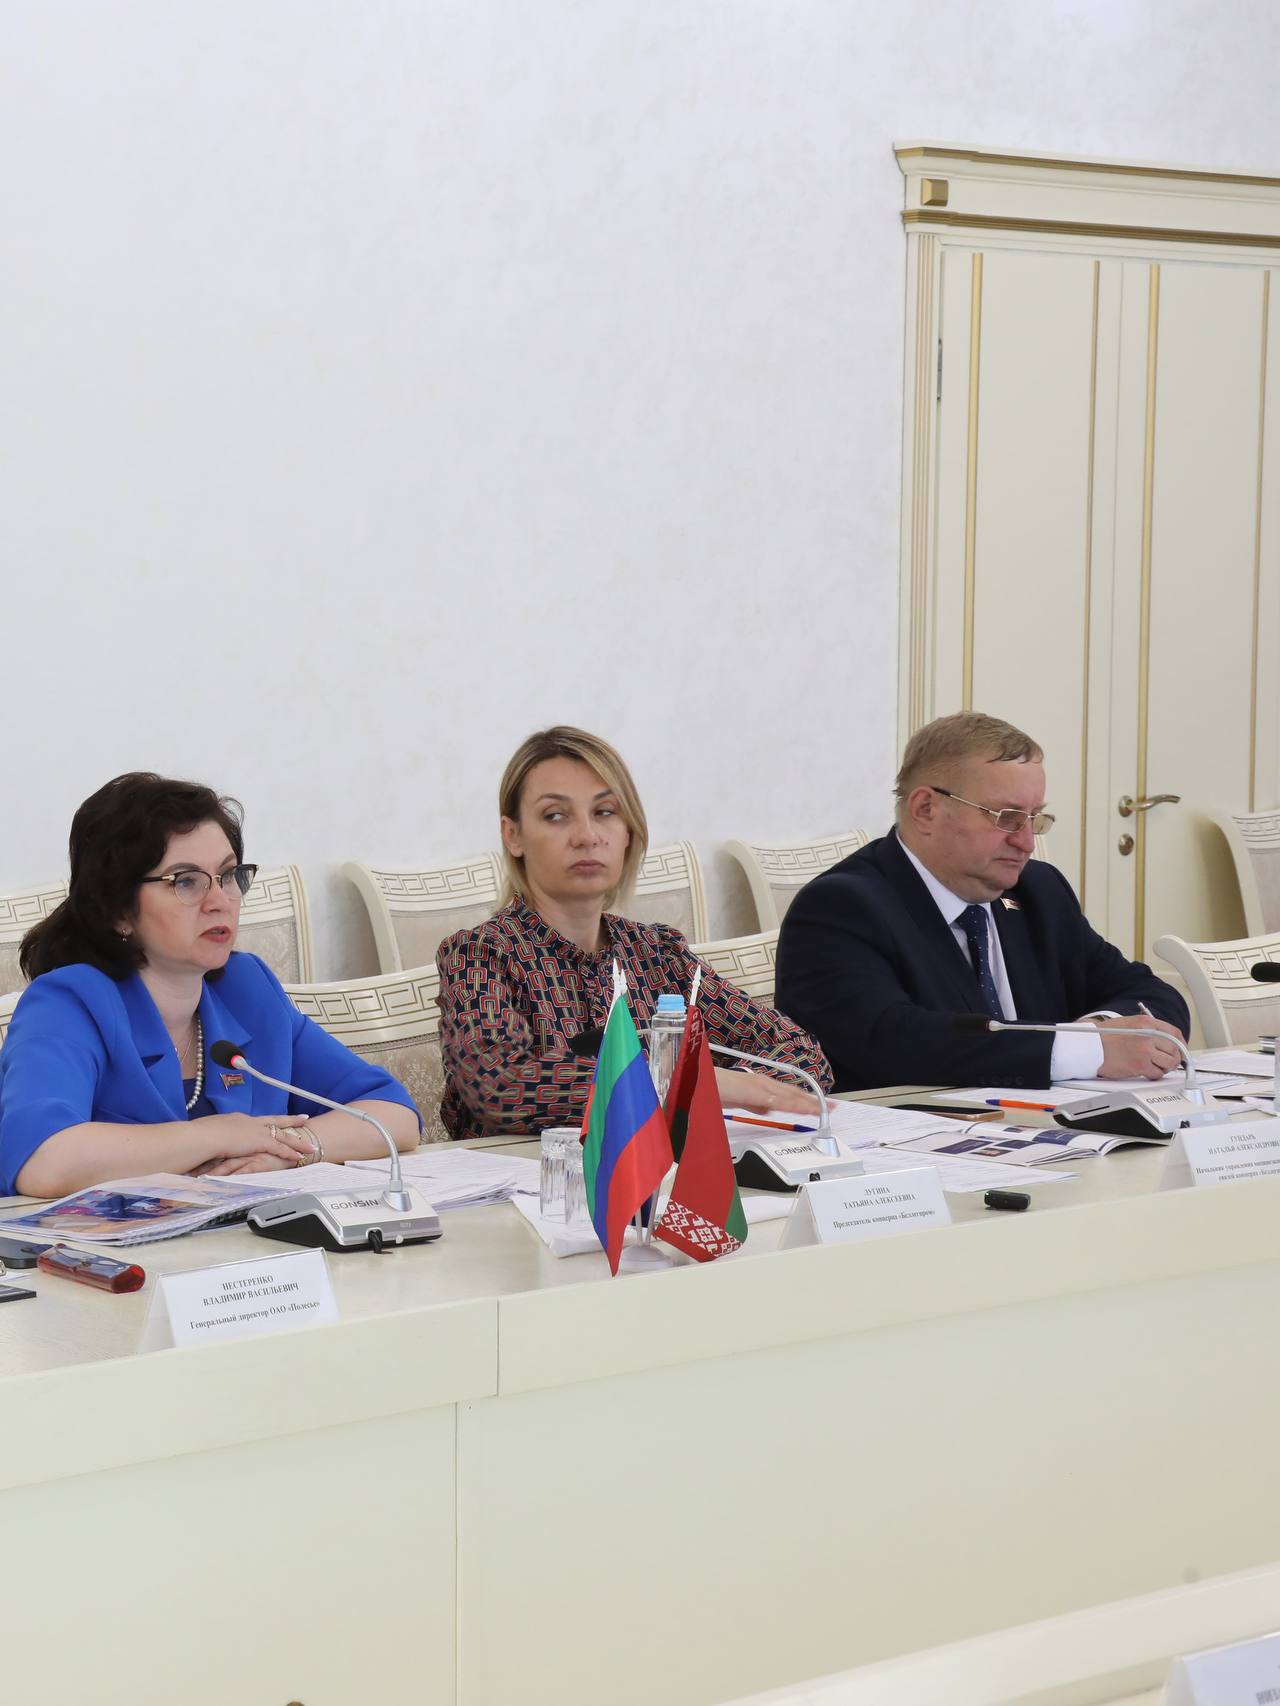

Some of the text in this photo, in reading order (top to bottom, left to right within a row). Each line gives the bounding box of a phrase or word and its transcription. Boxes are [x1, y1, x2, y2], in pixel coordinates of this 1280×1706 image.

[1145, 1094, 1181, 1104] GONSIN
[774, 1144, 812, 1156] GONSIN
[1236, 1140, 1280, 1152] АЛЕКСАНДРОВН
[330, 1199, 379, 1210] GONSIN
[843, 1194, 916, 1210] ТАТЬЯНА АЛЕКСЕЕВНА
[832, 1217, 871, 1230] Председатель
[222, 1275, 274, 1291] НЕСТЕРЕНКО
[203, 1282, 299, 1307] ВЛАДИМИР ВАСИЛЬЕВИЧ
[190, 1300, 321, 1330] Генеральный директор ОАО «Полесье»
